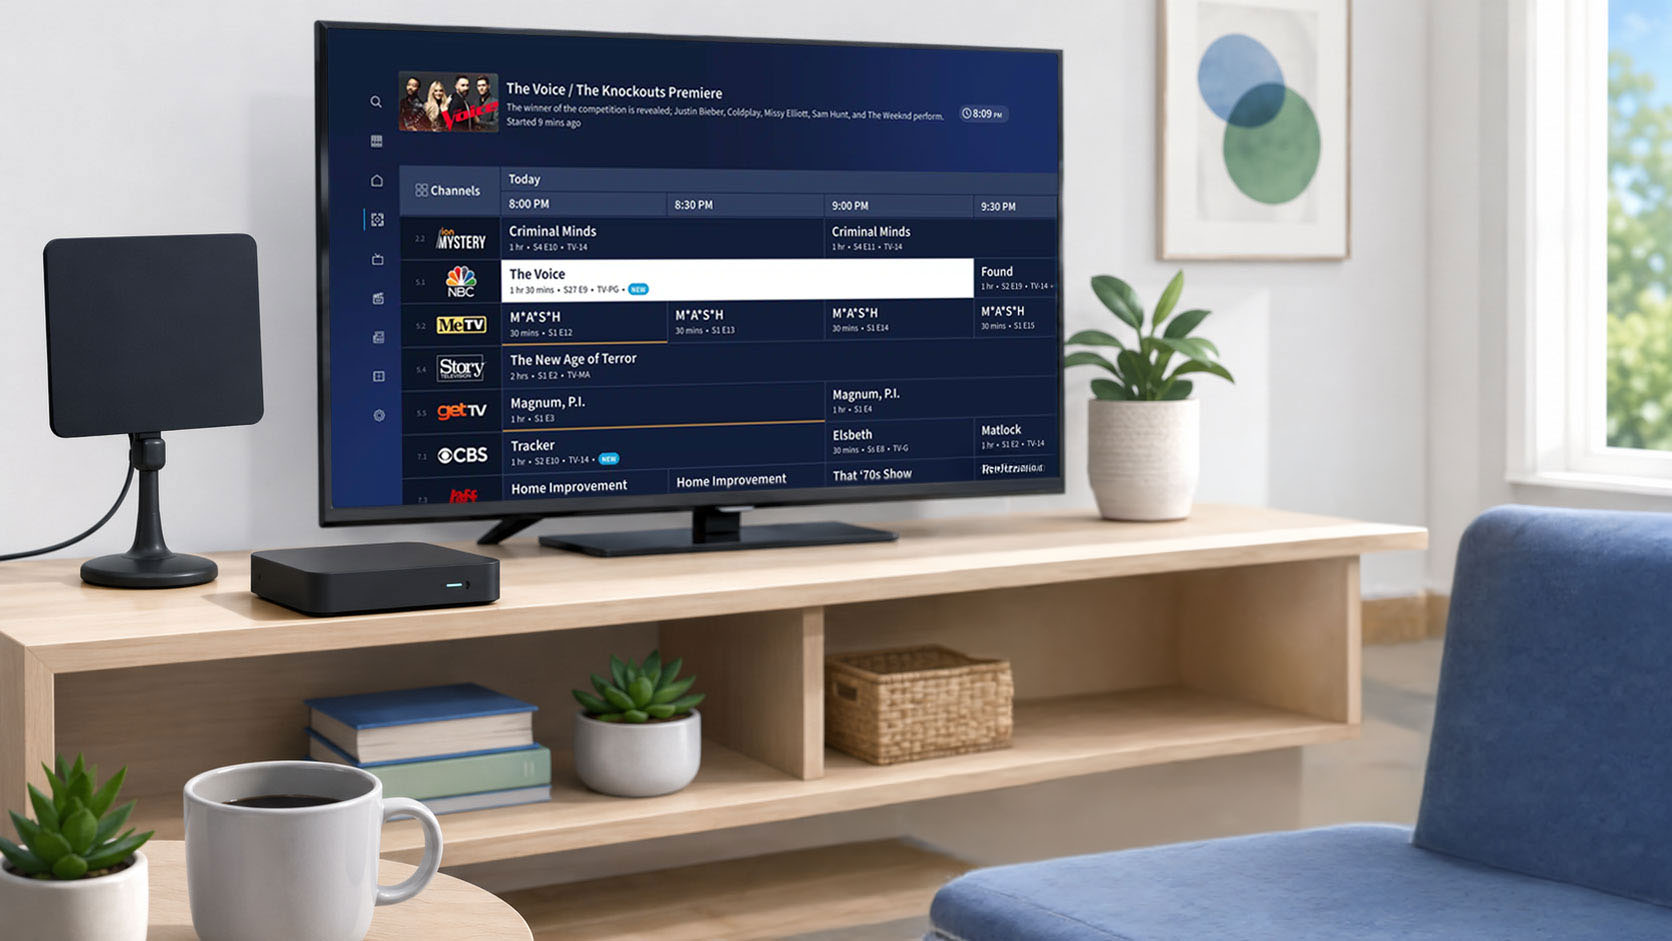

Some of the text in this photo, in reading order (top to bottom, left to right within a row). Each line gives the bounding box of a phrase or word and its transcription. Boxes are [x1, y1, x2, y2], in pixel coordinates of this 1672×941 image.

[506, 82, 530, 95] The
[532, 83, 566, 96] Voice
[576, 84, 599, 96] The
[602, 85, 666, 98] Knockouts
[669, 86, 723, 99] Premiere
[506, 103, 944, 122] The winner of the competition is revealed; Justin Bieber, Coldplay, Missy Elliott, Sam Hunt, and The Weeknd perform.
[973, 109, 992, 119] 8:09
[506, 117, 582, 129] Started 9 mins ago
[509, 174, 541, 187] Today
[431, 185, 480, 196] Channels
[509, 198, 549, 209] 8:00 PM
[674, 200, 713, 210] 8:30 PM
[832, 201, 869, 211] 9:00 PM
[981, 202, 1016, 212] 9:30 PM
[509, 225, 597, 237] Criminal Minds
[832, 226, 911, 237] Criminal Minds
[438, 235, 486, 249] MYSTERY
[510, 243, 514, 251] 1
[533, 243, 543, 251] S4
[544, 243, 558, 251] E10
[567, 243, 588, 251] TV-14
[832, 243, 836, 251] 1
[853, 243, 862, 251] S4
[863, 243, 875, 251] E11
[884, 243, 903, 251] TV-14
[509, 268, 566, 280] The Voice
[981, 266, 1013, 277] Found
[510, 286, 514, 295] 1
[515, 286, 524, 294] hr
[525, 286, 535, 294] 30
[536, 286, 555, 294] mins
[563, 285, 577, 294] S27
[578, 285, 588, 294] E9
[597, 285, 620, 294] TV-PG
[986, 282, 994, 290] hr
[1001, 282, 1010, 290] S2
[1010, 282, 1023, 290] E19
[1030, 282, 1048, 290] TV-14
[448, 287, 475, 297] NBC
[675, 327, 684, 335] 30
[711, 326, 720, 335] S1
[721, 326, 736, 334] E13
[832, 323, 889, 332] 30 mins S1 E14
[981, 322, 989, 330] 30
[990, 322, 1006, 330] mins
[1014, 322, 1022, 330] S1
[510, 328, 573, 337] 30 mins S1 E12
[510, 352, 637, 368] The New Age of Terror
[440, 359, 486, 377] Story
[510, 371, 591, 380] 2 hrs S1 E2 TV-MA
[833, 388, 900, 403] Magnum, P.I.
[511, 396, 585, 412] Magnum, P.I.
[833, 406, 837, 414] 1
[854, 405, 862, 413] S1
[863, 405, 872, 413] E4
[511, 414, 555, 423] 1 hr S1 E3
[833, 429, 872, 441] Elsbeth
[982, 424, 1021, 435] Matlock
[511, 439, 555, 451] Tracker
[833, 446, 841, 455] 30
[842, 446, 859, 454] mins
[876, 445, 886, 453] E8
[893, 444, 909, 452] TV-G
[982, 442, 985, 450] 1
[986, 441, 994, 449] hr
[1001, 440, 1010, 448] S1
[1011, 440, 1019, 448] E2
[453, 447, 488, 463] CBS
[511, 458, 515, 466] 1
[535, 457, 544, 465] S2
[545, 457, 560, 465] E10
[568, 456, 589, 464] TV-14
[833, 470, 857, 481] That
[883, 468, 912, 480] Show
[677, 473, 787, 489] Home Improvement
[512, 479, 628, 495] Home Improvement
